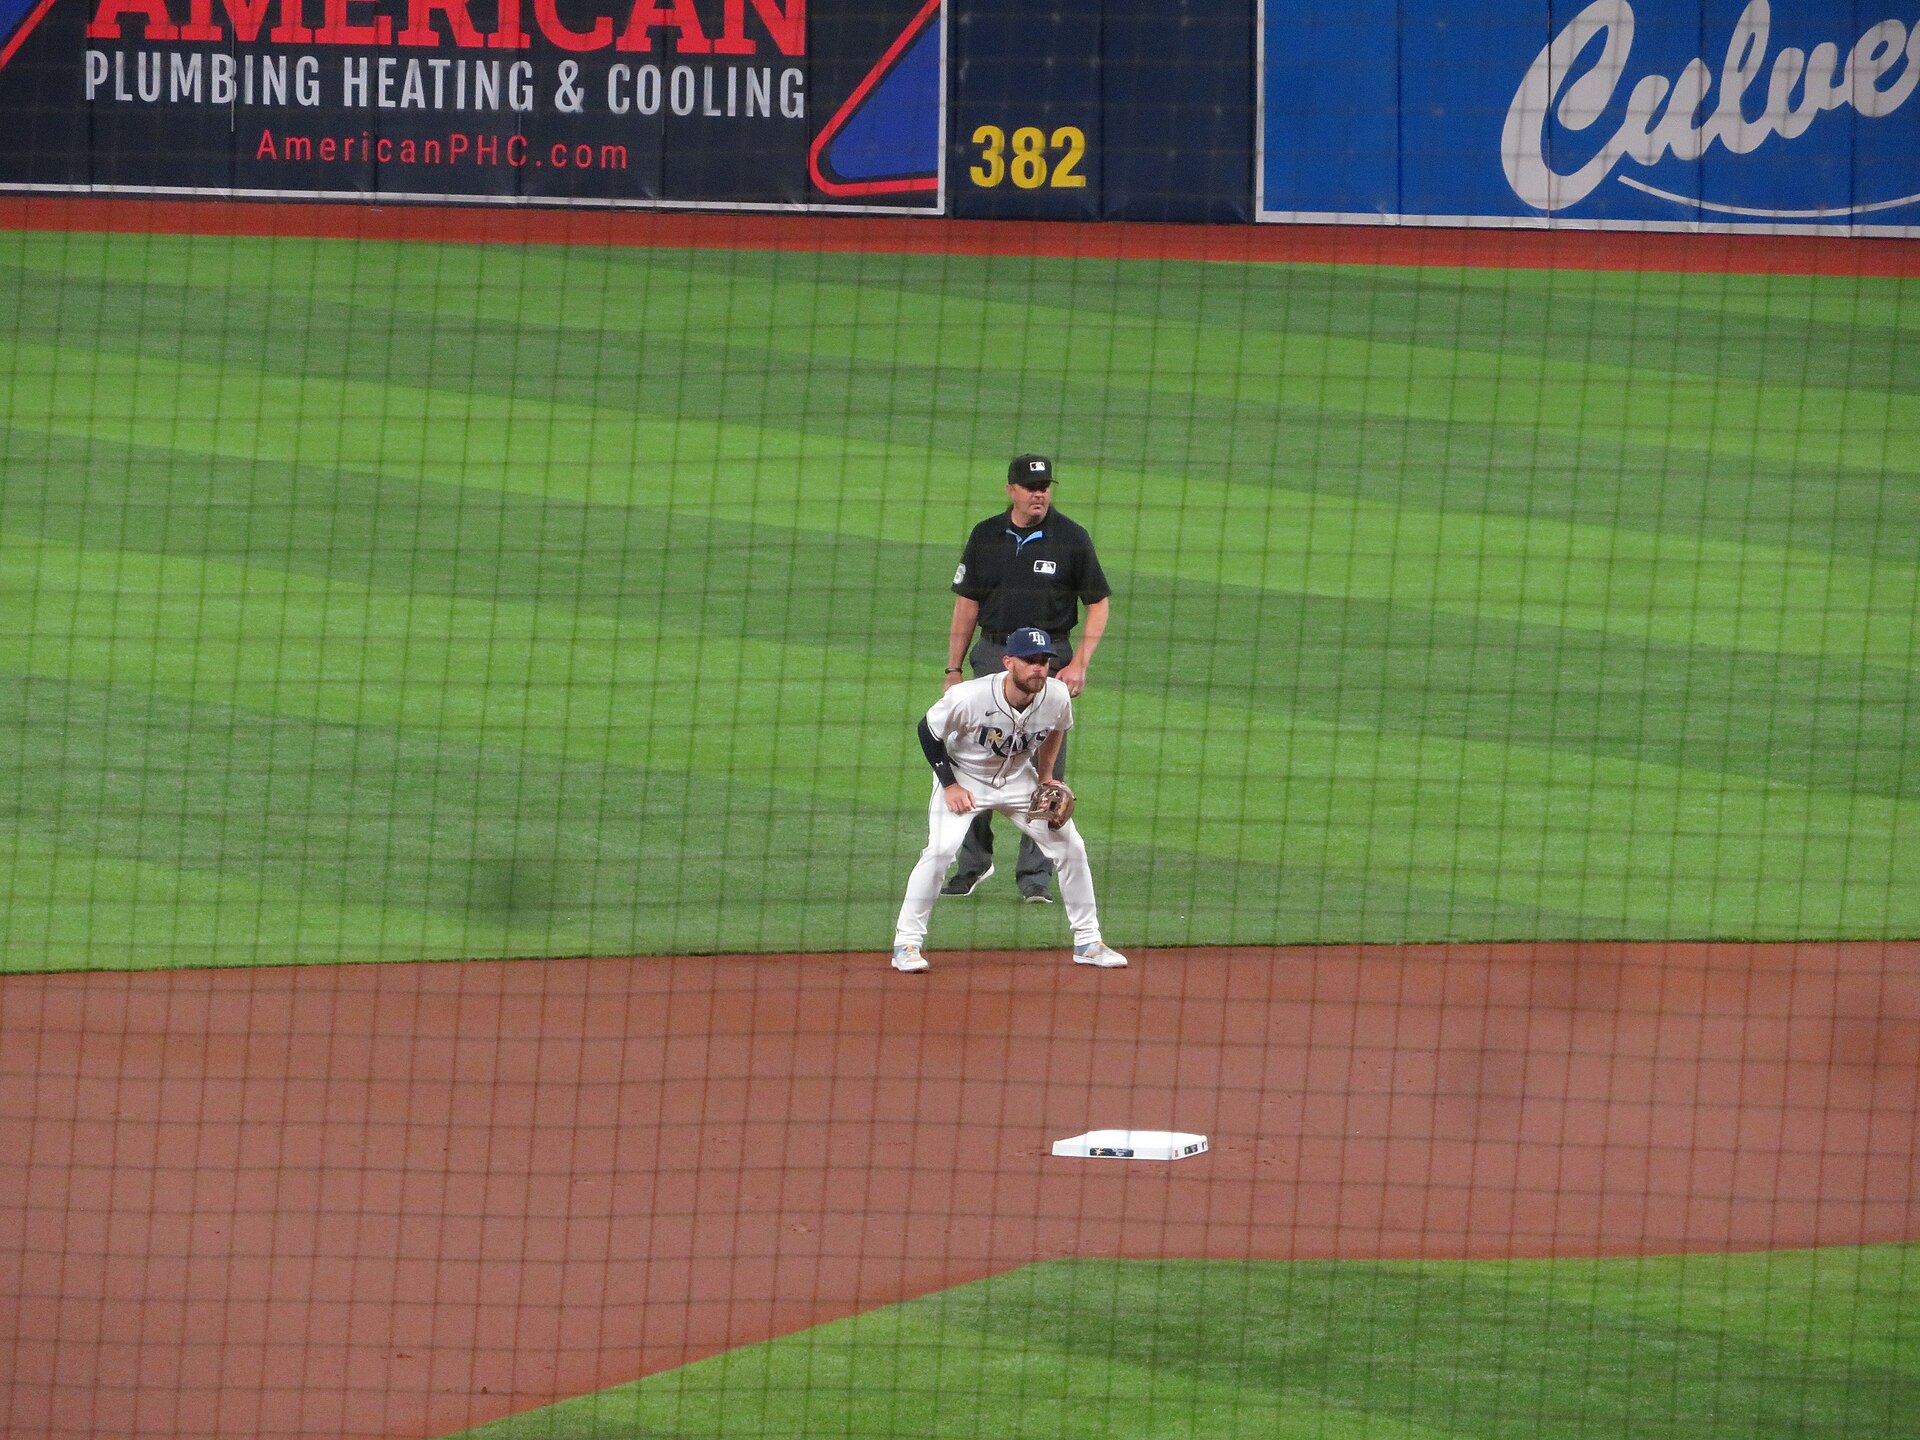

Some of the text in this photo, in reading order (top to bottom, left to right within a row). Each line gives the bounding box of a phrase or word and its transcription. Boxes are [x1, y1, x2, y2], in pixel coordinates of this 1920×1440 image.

[85, 50, 805, 119] PLUMBING HEATING & COOLING
[1501, 0, 1920, 210] Culve
[256, 129, 628, 170] AmericanPHC.com
[969, 125, 1087, 189] 382
